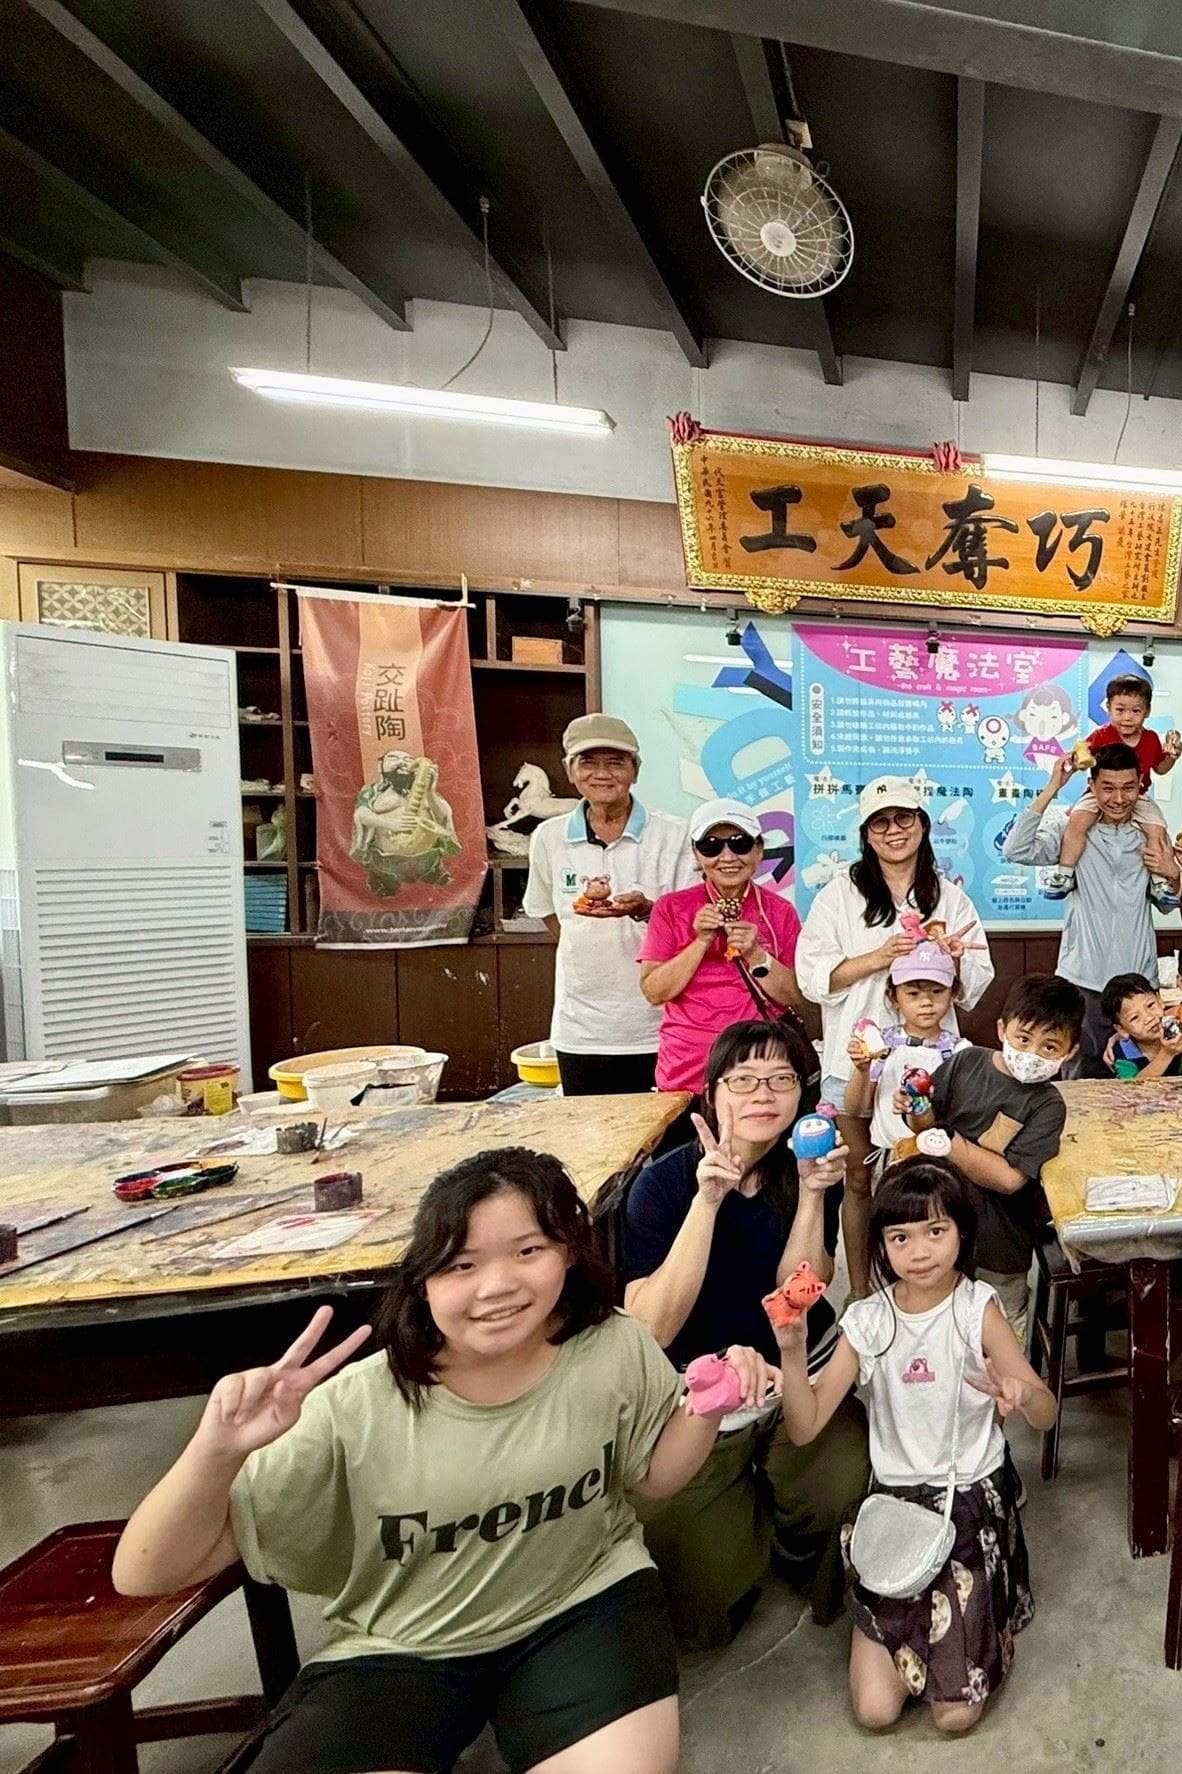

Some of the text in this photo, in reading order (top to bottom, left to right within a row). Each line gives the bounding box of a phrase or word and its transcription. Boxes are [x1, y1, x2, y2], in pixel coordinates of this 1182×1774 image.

[848, 643, 1037, 684] 工藝魔法室
[373, 663, 407, 741] 交趾陶
[811, 699, 823, 750] 安全須知
[1032, 743, 1056, 754] SAFE
[913, 785, 974, 798] 捏魔法陶
